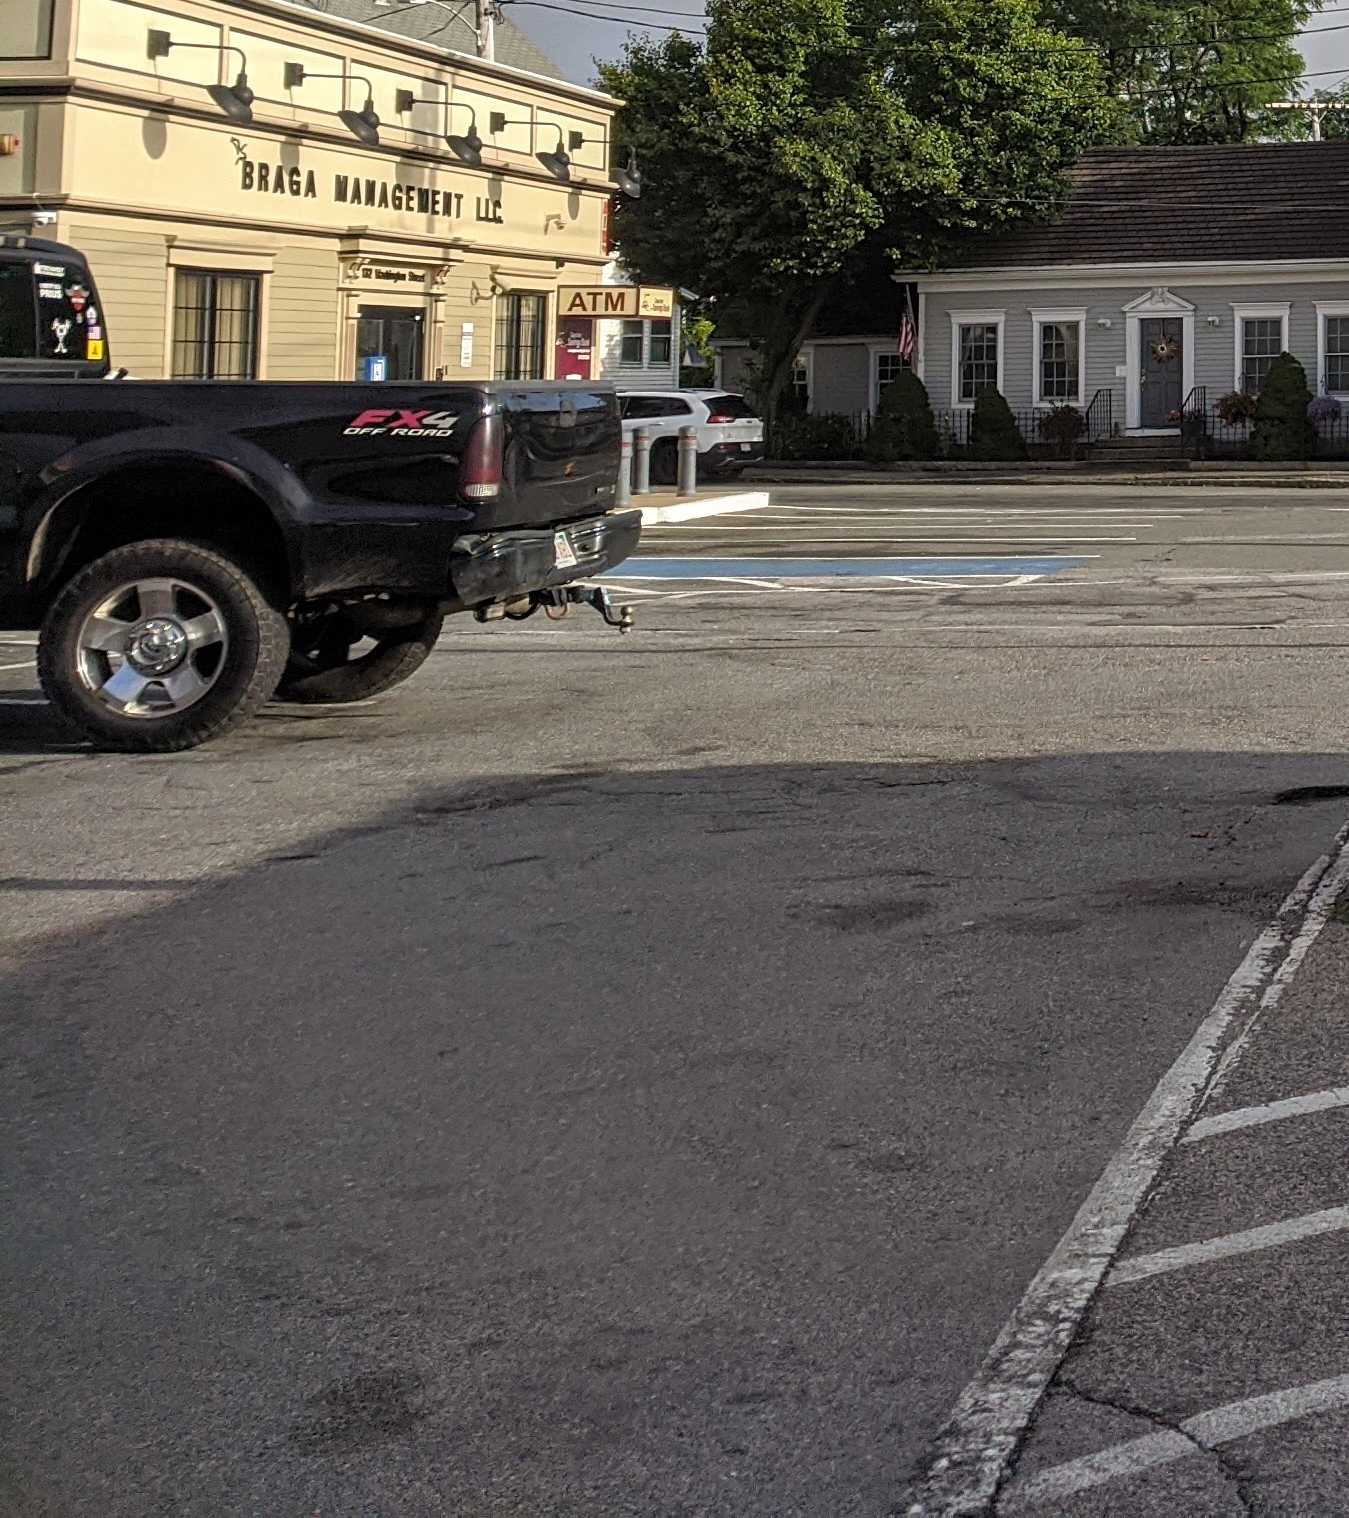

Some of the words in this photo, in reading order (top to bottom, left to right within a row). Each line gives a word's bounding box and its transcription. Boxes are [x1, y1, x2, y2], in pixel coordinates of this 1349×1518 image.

[240, 160, 317, 199] BRAGA
[333, 174, 464, 219] MANAGEMENT
[567, 291, 626, 312] ATM
[350, 409, 460, 429] FX4
[342, 427, 388, 436] OFF
[390, 428, 454, 437] ROAD
